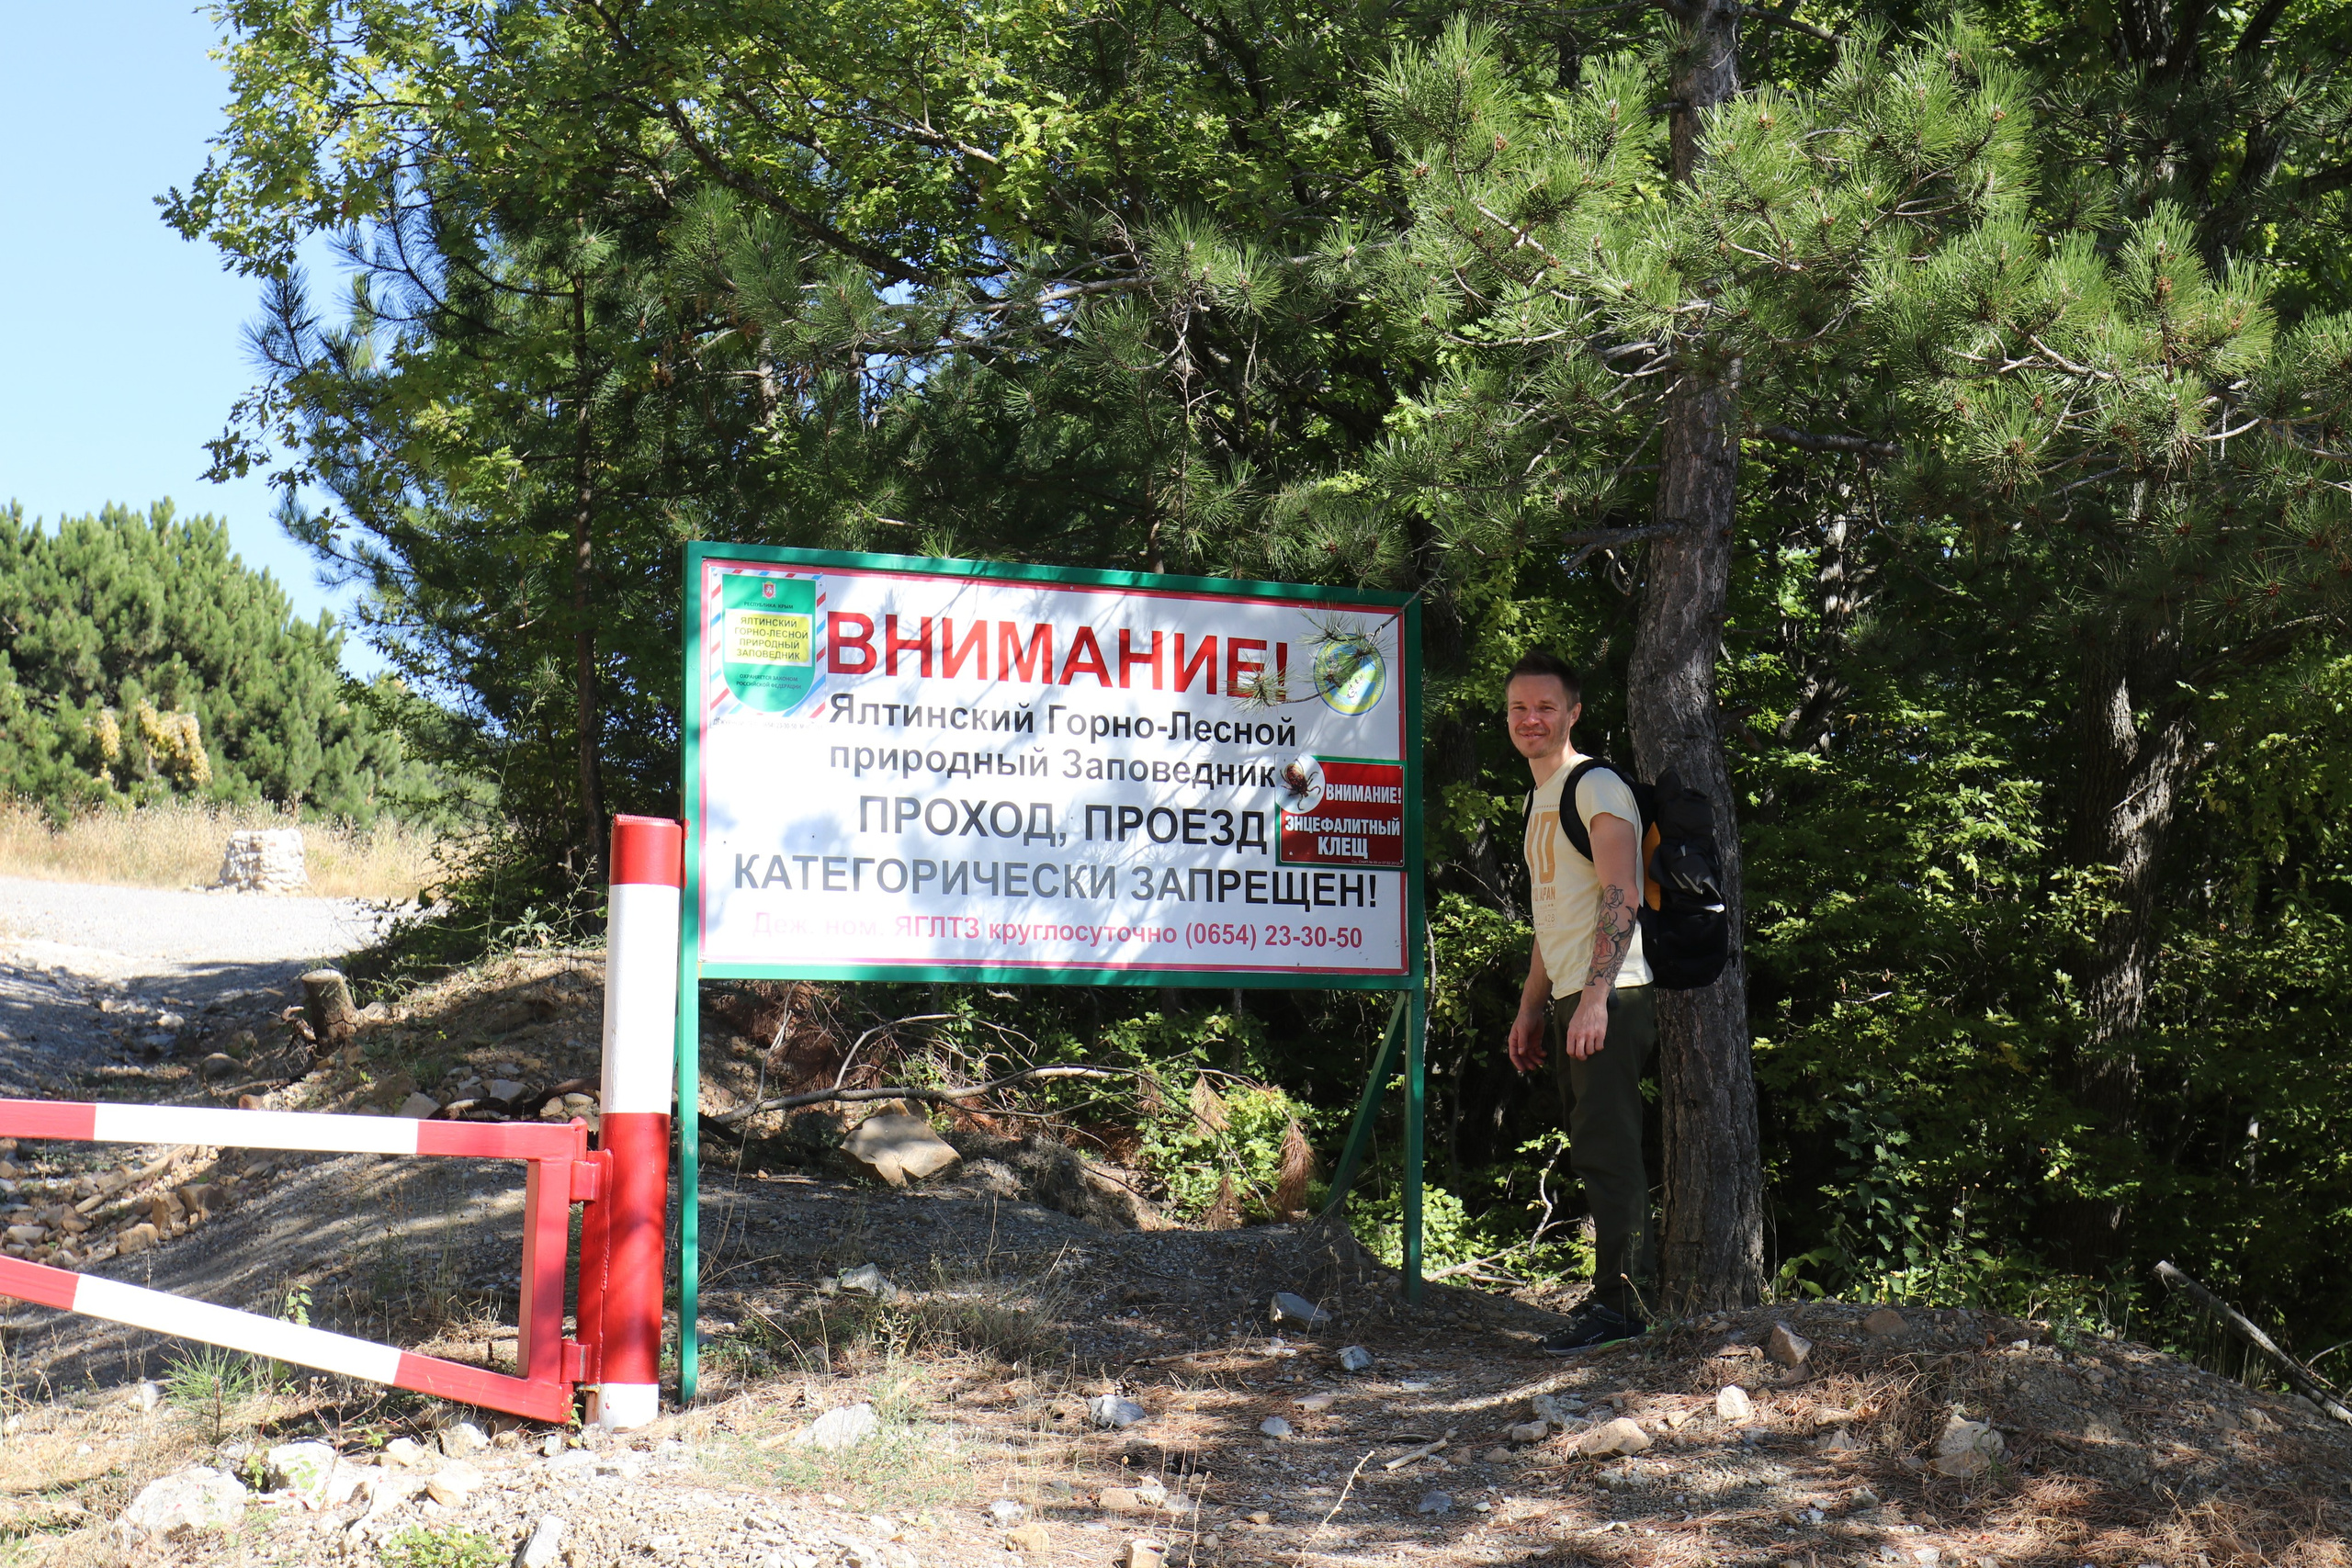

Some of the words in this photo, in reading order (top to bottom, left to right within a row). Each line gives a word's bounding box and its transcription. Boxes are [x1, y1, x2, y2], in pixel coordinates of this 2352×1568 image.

[735, 627, 808, 639] ГОРНО-ЛЕСНОЙ
[741, 616, 797, 628] ЯЛТИНСКИЙ
[737, 649, 800, 660] ЗАПОВЕДНИК
[740, 638, 800, 649] ПРИРОДНЫЙ
[827, 610, 1288, 701] ВНИМАНИЕ!
[830, 694, 1033, 733] Ялтинский
[1048, 705, 1296, 747] Горно-Лесной
[831, 745, 1048, 780] природный
[1062, 749, 1276, 790] Заповедник
[1326, 784, 1402, 804] ВНИМАНИЕ!
[860, 795, 1067, 847] ПРОХОД,
[1085, 804, 1268, 855] ПРОЕЗД
[1284, 815, 1400, 836] ЭНЦЕФАЛИТНЫЙ
[1317, 836, 1368, 859] КЛЕЩ
[735, 852, 1116, 900] КАТЕГОРИЧЕСКИ
[1130, 866, 1377, 912] ЗАПРЕЩЕН!
[752, 911, 814, 937] Деж.
[826, 919, 885, 936] ном.
[895, 915, 979, 939] ЯГЛТЗ
[989, 921, 1178, 947] круглосуточно
[1185, 921, 1257, 951] (0654)
[1265, 923, 1363, 948] 23-30-50
